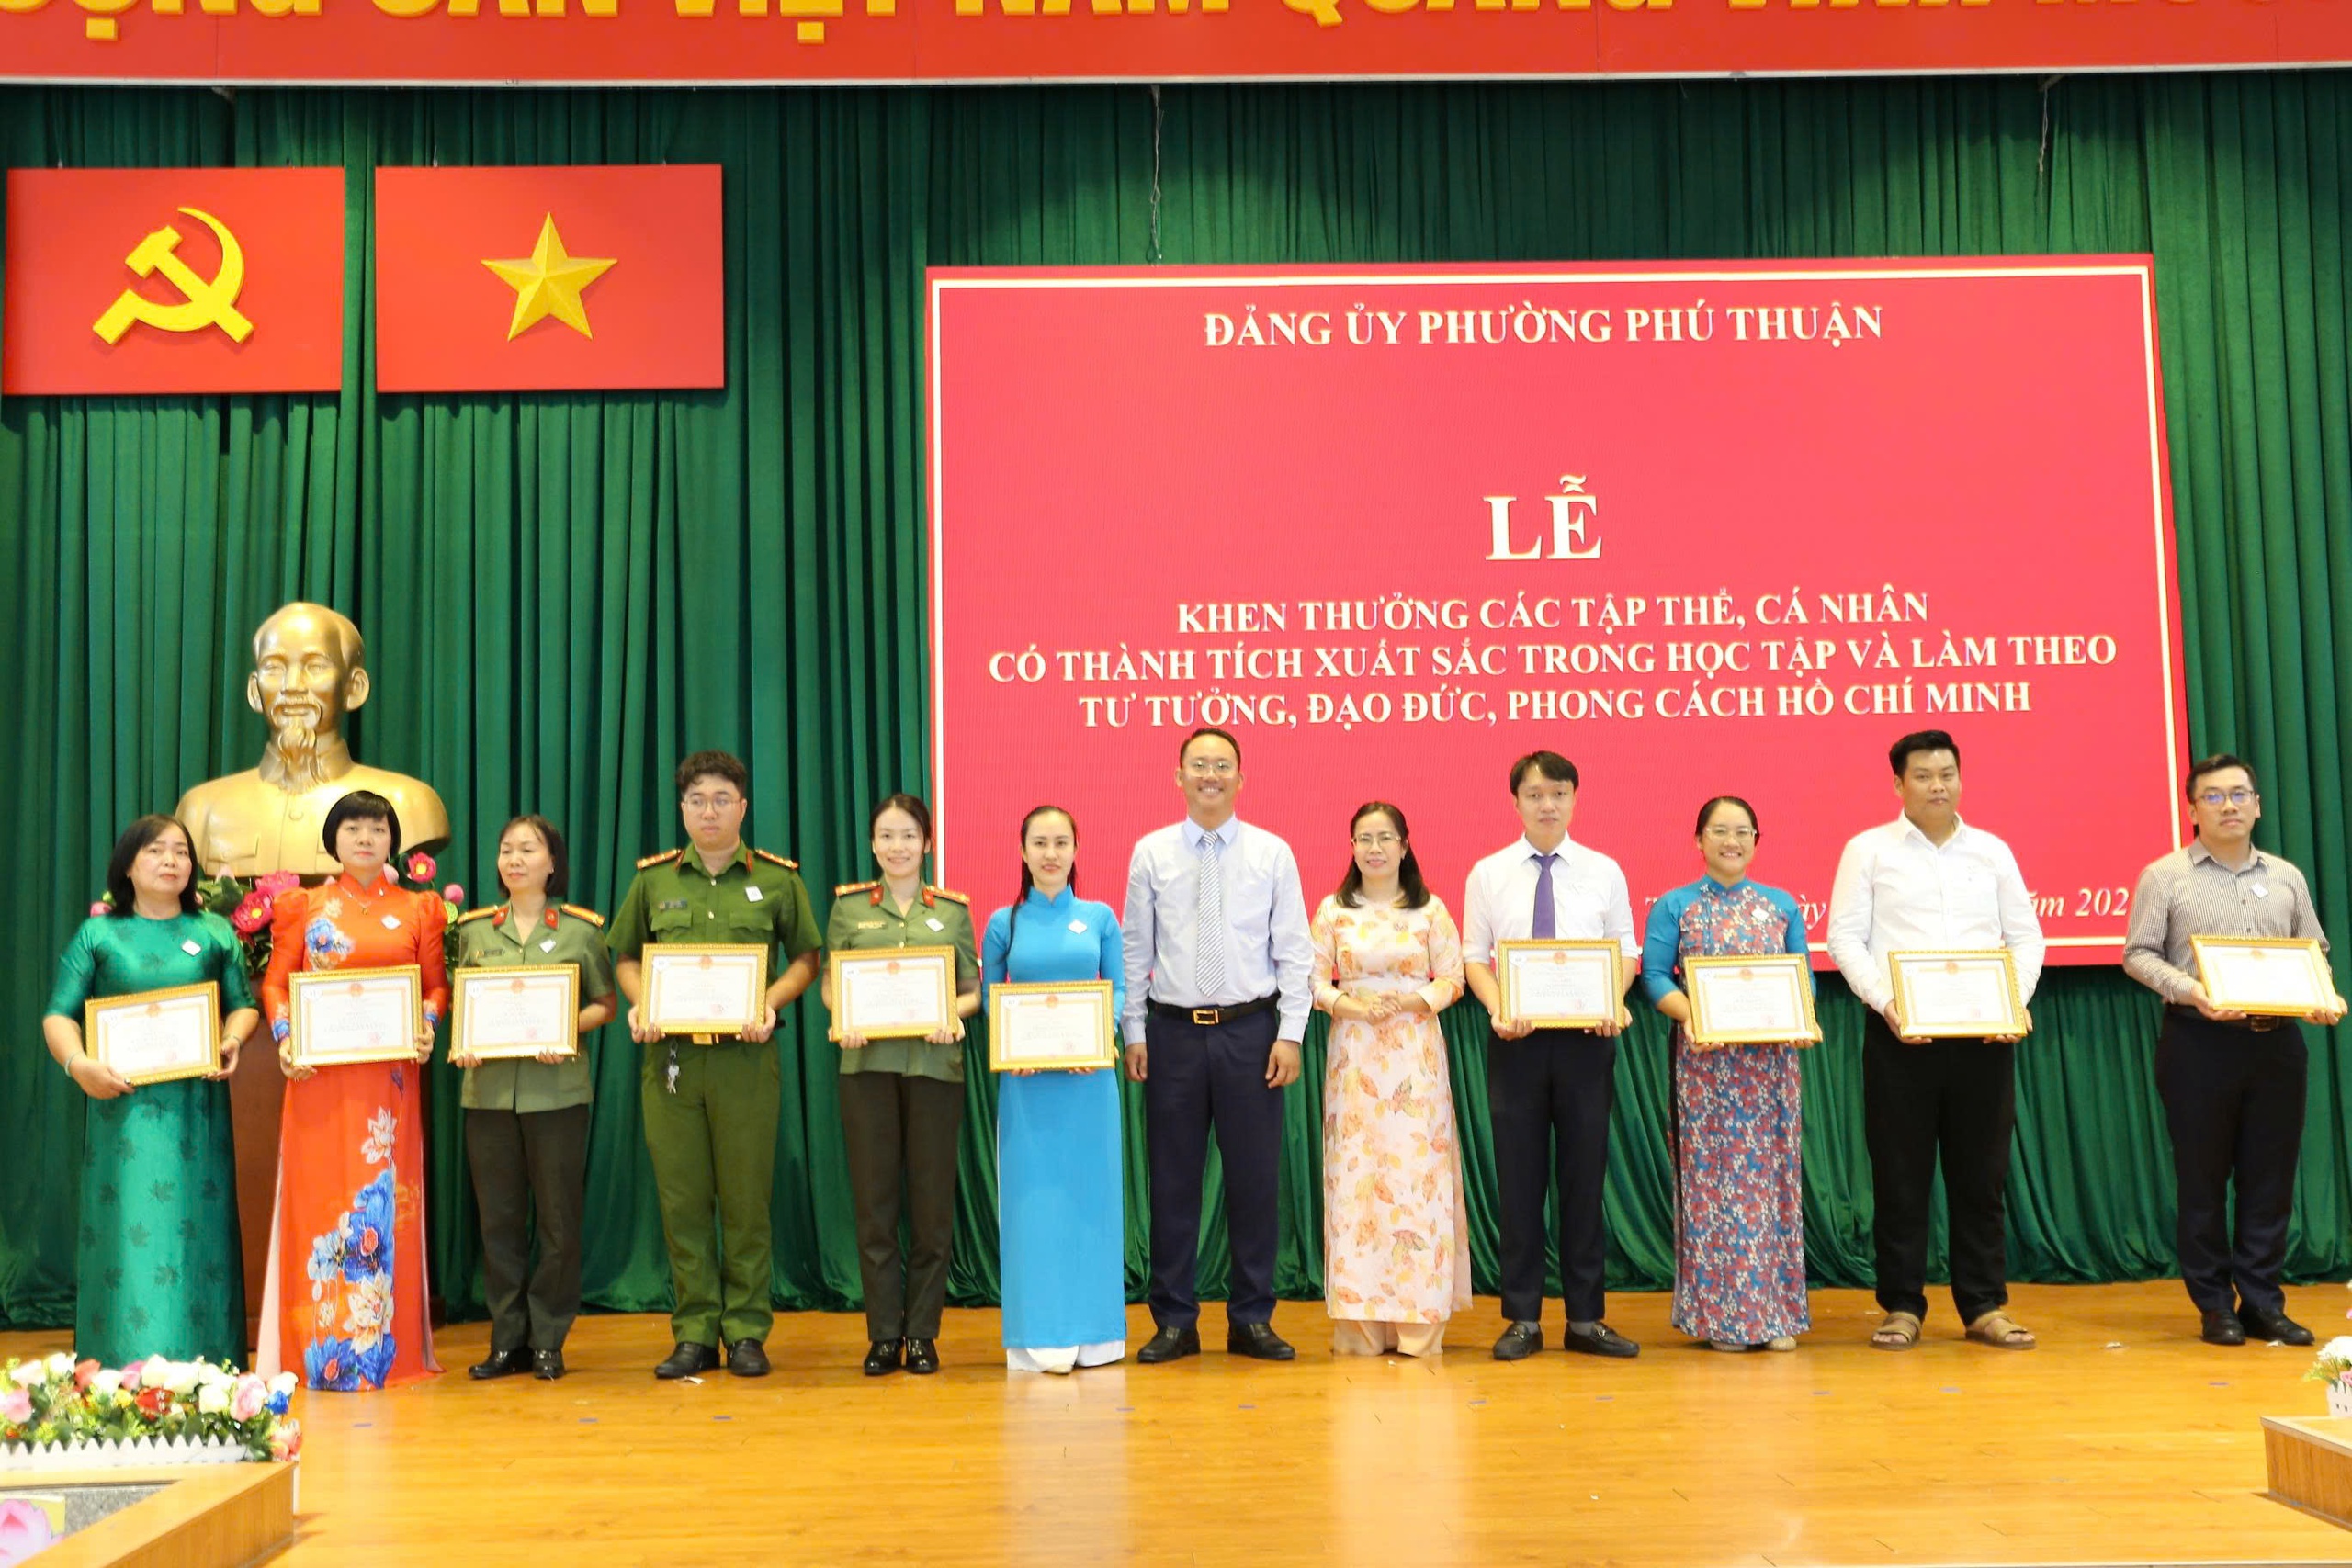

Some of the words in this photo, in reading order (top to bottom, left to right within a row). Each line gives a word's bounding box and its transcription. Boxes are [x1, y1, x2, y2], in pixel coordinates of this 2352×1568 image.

[1204, 304, 1331, 346] ĐẢNG
[1345, 302, 1407, 344] ỦY
[1419, 300, 1611, 344] PHƯỜNG
[1625, 299, 1714, 342] PHÚ
[1725, 301, 1882, 348] THUẬN
[1483, 474, 1602, 560] LỄ
[1178, 602, 1287, 634] KHEN
[1297, 592, 1469, 631] THƯỞNG
[1479, 590, 1560, 629] CÁC
[1570, 592, 1646, 635] TẬP
[1656, 587, 1746, 630] THỂ,
[1755, 586, 1809, 625] CÁ
[1819, 583, 1928, 624] NHÂN
[989, 643, 1046, 682] CÓ
[1056, 642, 1196, 682] THÀNH
[1205, 640, 1303, 679] TÍCH
[1314, 638, 1421, 677] XUẤT
[1431, 637, 1507, 676] SẮC
[1517, 643, 1655, 674] TRONG
[1666, 641, 1750, 680] HỌC
[1760, 636, 1837, 678] TẬP
[1846, 630, 1901, 669] VÀ
[1911, 629, 1997, 668] LÀM
[2007, 635, 2117, 666] THEO
[1078, 692, 1137, 728] TƯ
[1144, 686, 1297, 729] TƯỞNG,
[1306, 692, 1392, 731] ĐẠO
[1401, 683, 1497, 726] ĐỨC,
[1508, 689, 1644, 720] PHONG
[1655, 679, 1765, 718] CÁCH
[1777, 677, 1834, 716] HỒ
[1844, 675, 1914, 715] CHÍ
[1925, 682, 2030, 714] MINH
